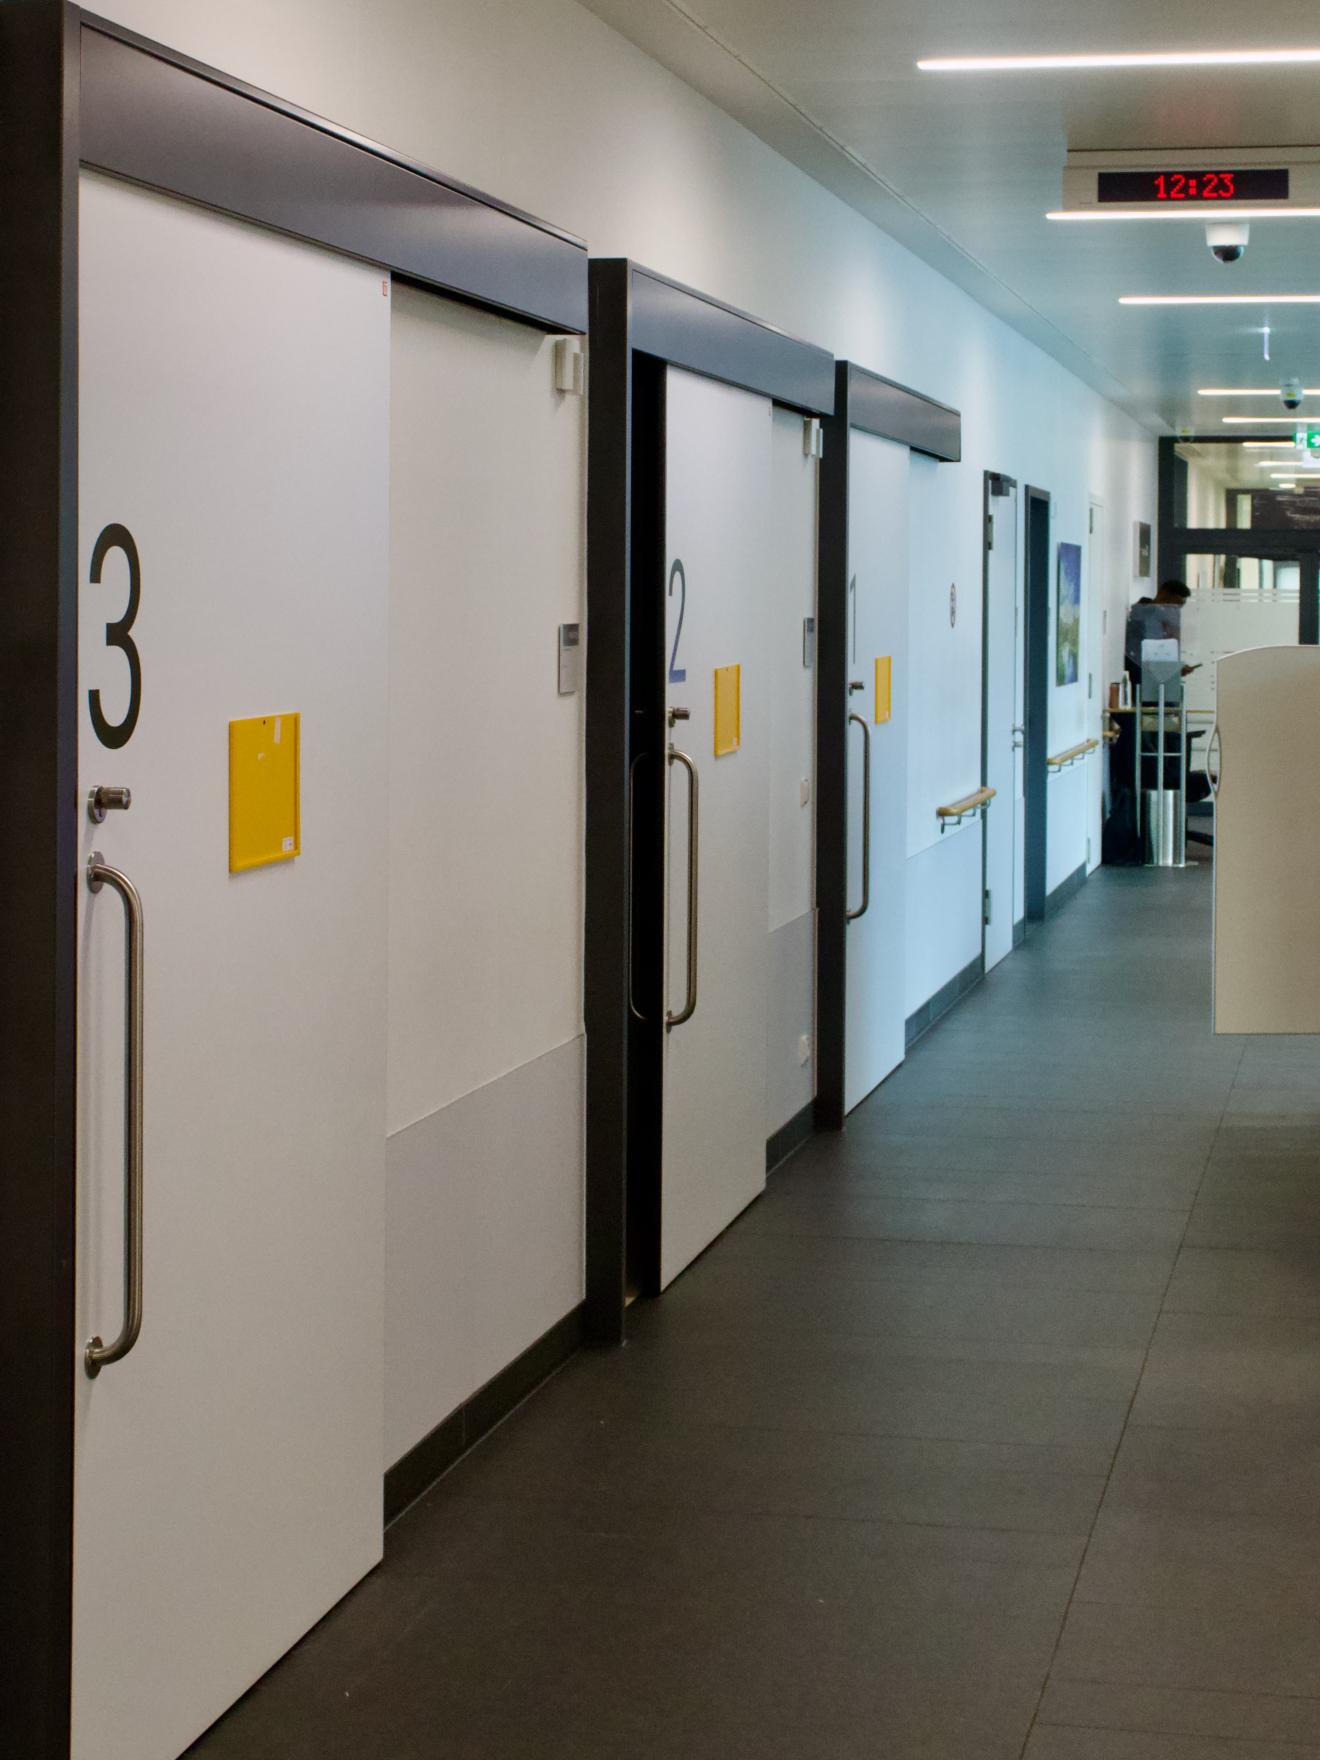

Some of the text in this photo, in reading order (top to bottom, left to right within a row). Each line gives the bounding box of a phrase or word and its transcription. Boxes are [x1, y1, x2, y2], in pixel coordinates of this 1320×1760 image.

[1154, 173, 1235, 199] 12:23
[88, 523, 141, 750] 3
[669, 558, 686, 683] 2
[849, 573, 856, 665] 1
